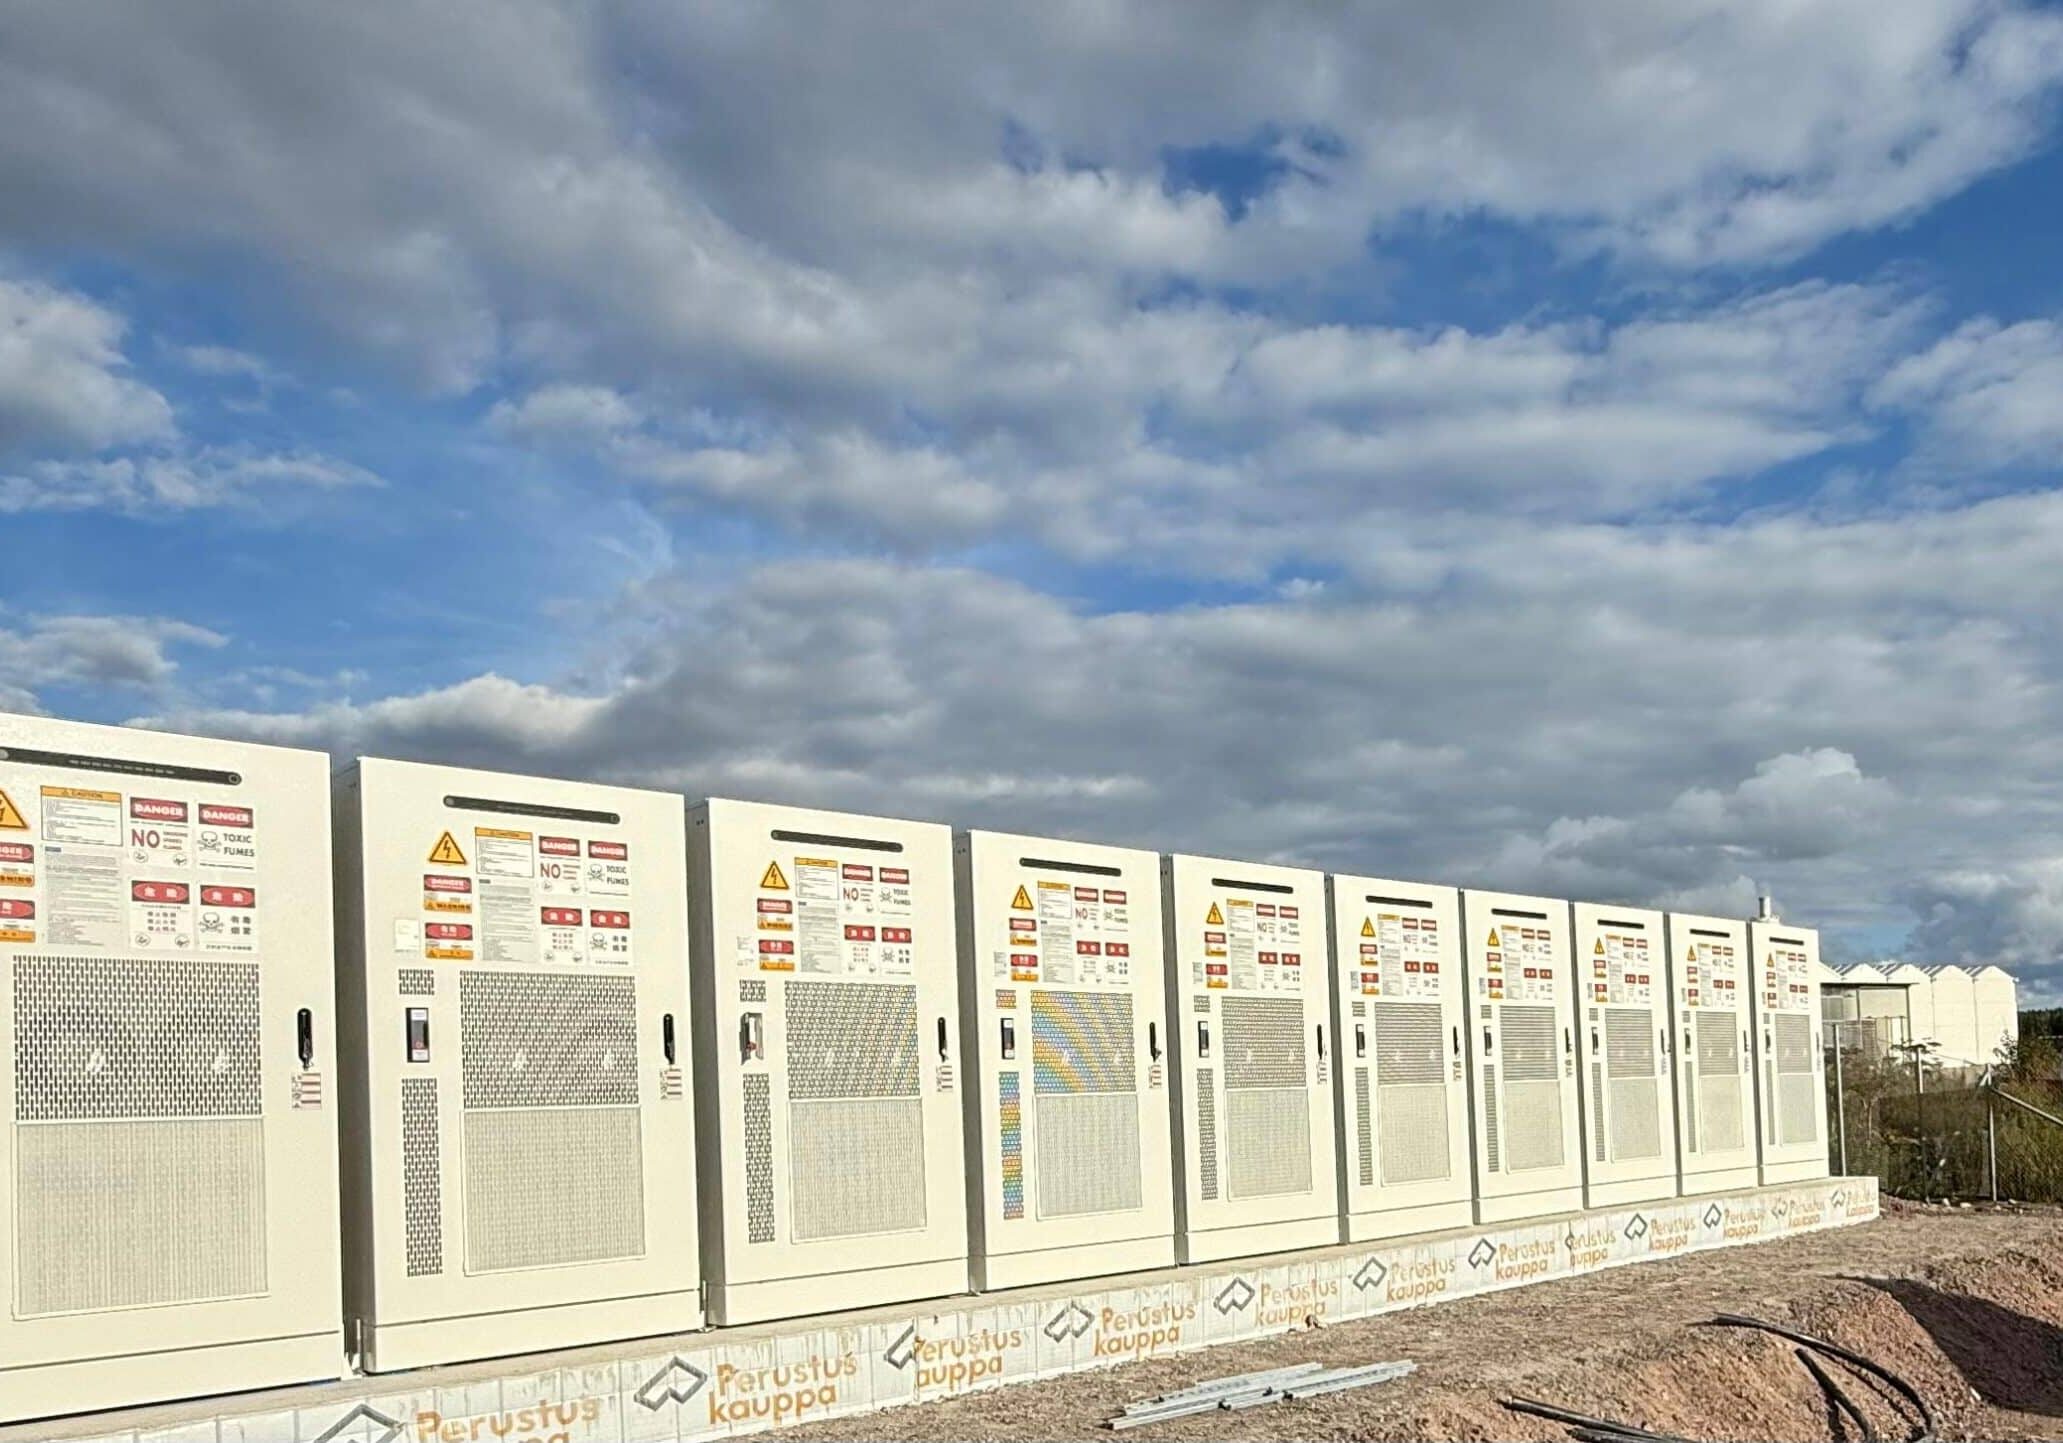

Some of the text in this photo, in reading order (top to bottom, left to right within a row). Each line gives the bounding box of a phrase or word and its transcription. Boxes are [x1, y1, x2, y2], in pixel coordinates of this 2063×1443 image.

[133, 803, 184, 817] DANGER
[202, 809, 249, 822] DANGER
[131, 828, 160, 848] NO
[223, 833, 251, 843] TOXIC
[224, 846, 255, 857] FUMES
[540, 863, 561, 879] NO
[843, 887, 859, 901] NO
[1499, 1240, 1555, 1264] Perustus
[1571, 1230, 1617, 1250] erustus
[1392, 1257, 1455, 1284] Perustus
[1495, 1259, 1548, 1282] kauppa
[1261, 1280, 1338, 1307] Perustus
[1386, 1279, 1446, 1303] kauppa
[1102, 1301, 1196, 1333] Perustus
[1254, 1302, 1326, 1328] kauppa
[1094, 1326, 1180, 1357] kauppa
[716, 1354, 857, 1396] Perustus
[917, 1356, 1003, 1392] auppa
[709, 1384, 837, 1424] kauppa
[416, 1399, 601, 1443] Perustus
